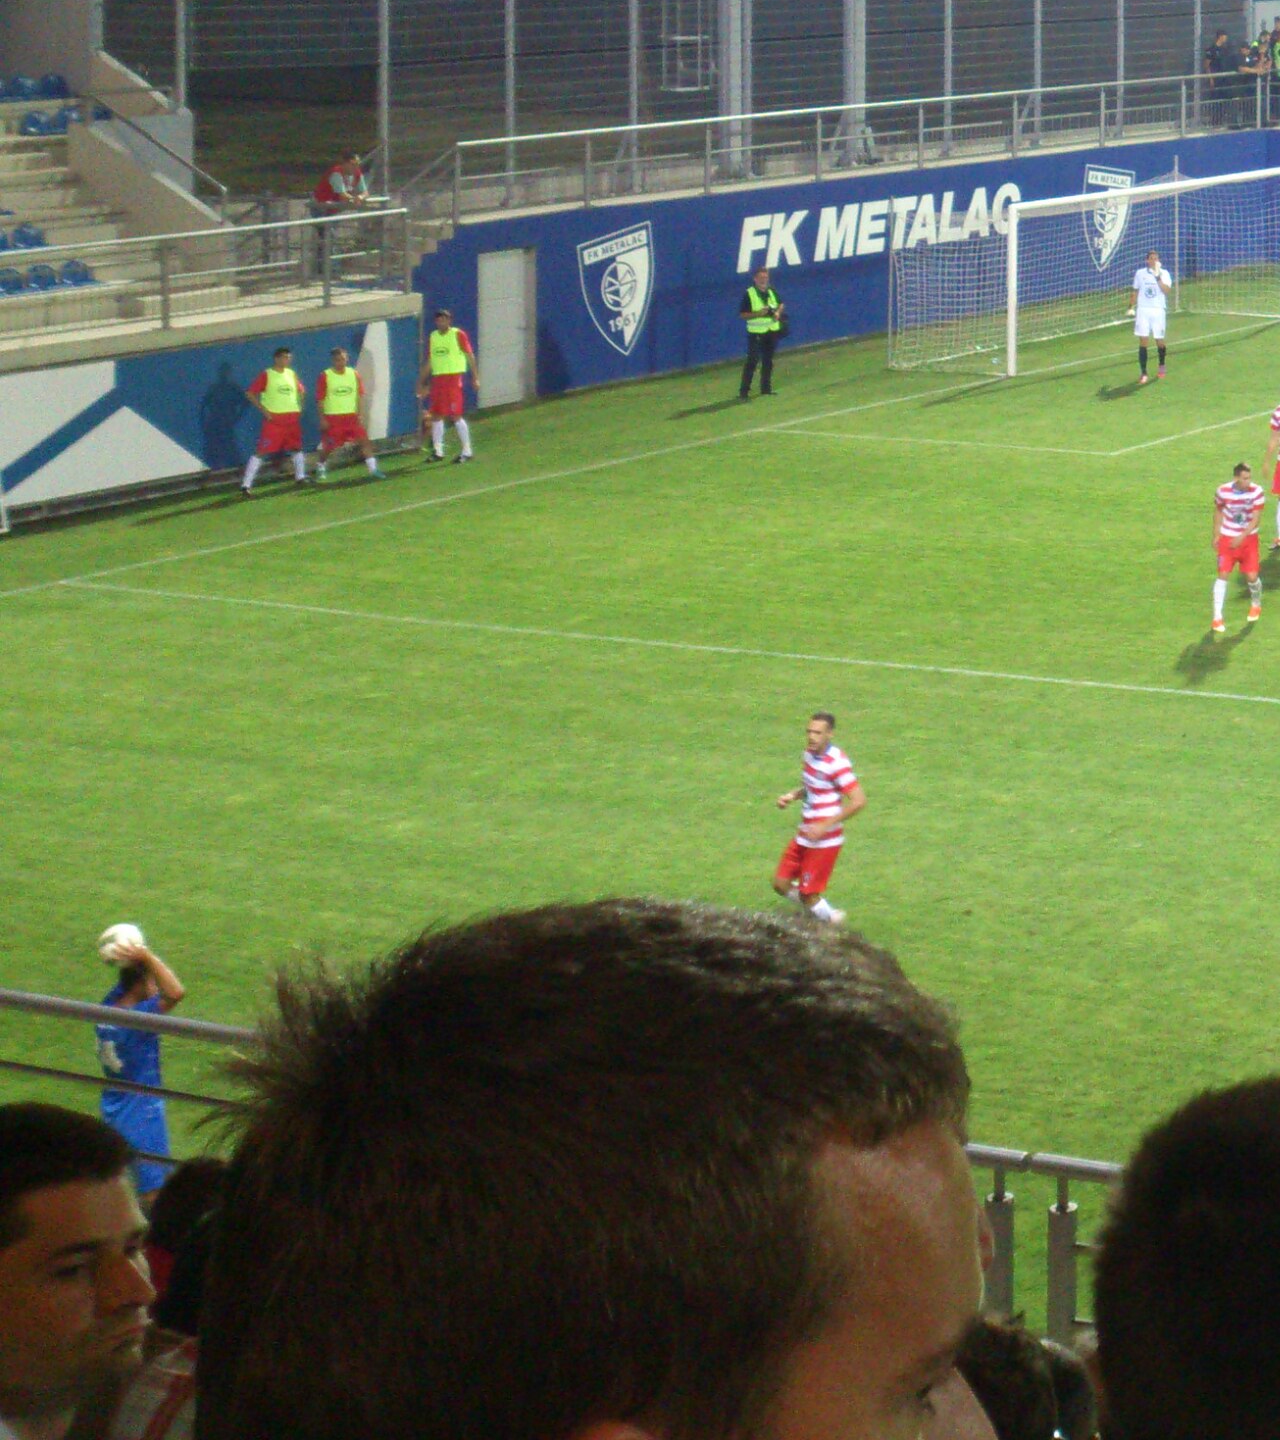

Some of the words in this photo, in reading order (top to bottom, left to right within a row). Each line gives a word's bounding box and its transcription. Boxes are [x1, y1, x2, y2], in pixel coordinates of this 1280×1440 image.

[736, 209, 809, 274] FK
[813, 182, 1022, 262] METALAC
[586, 249, 599, 261] FK
[600, 234, 645, 256] METALAC
[608, 312, 637, 333] 1961
